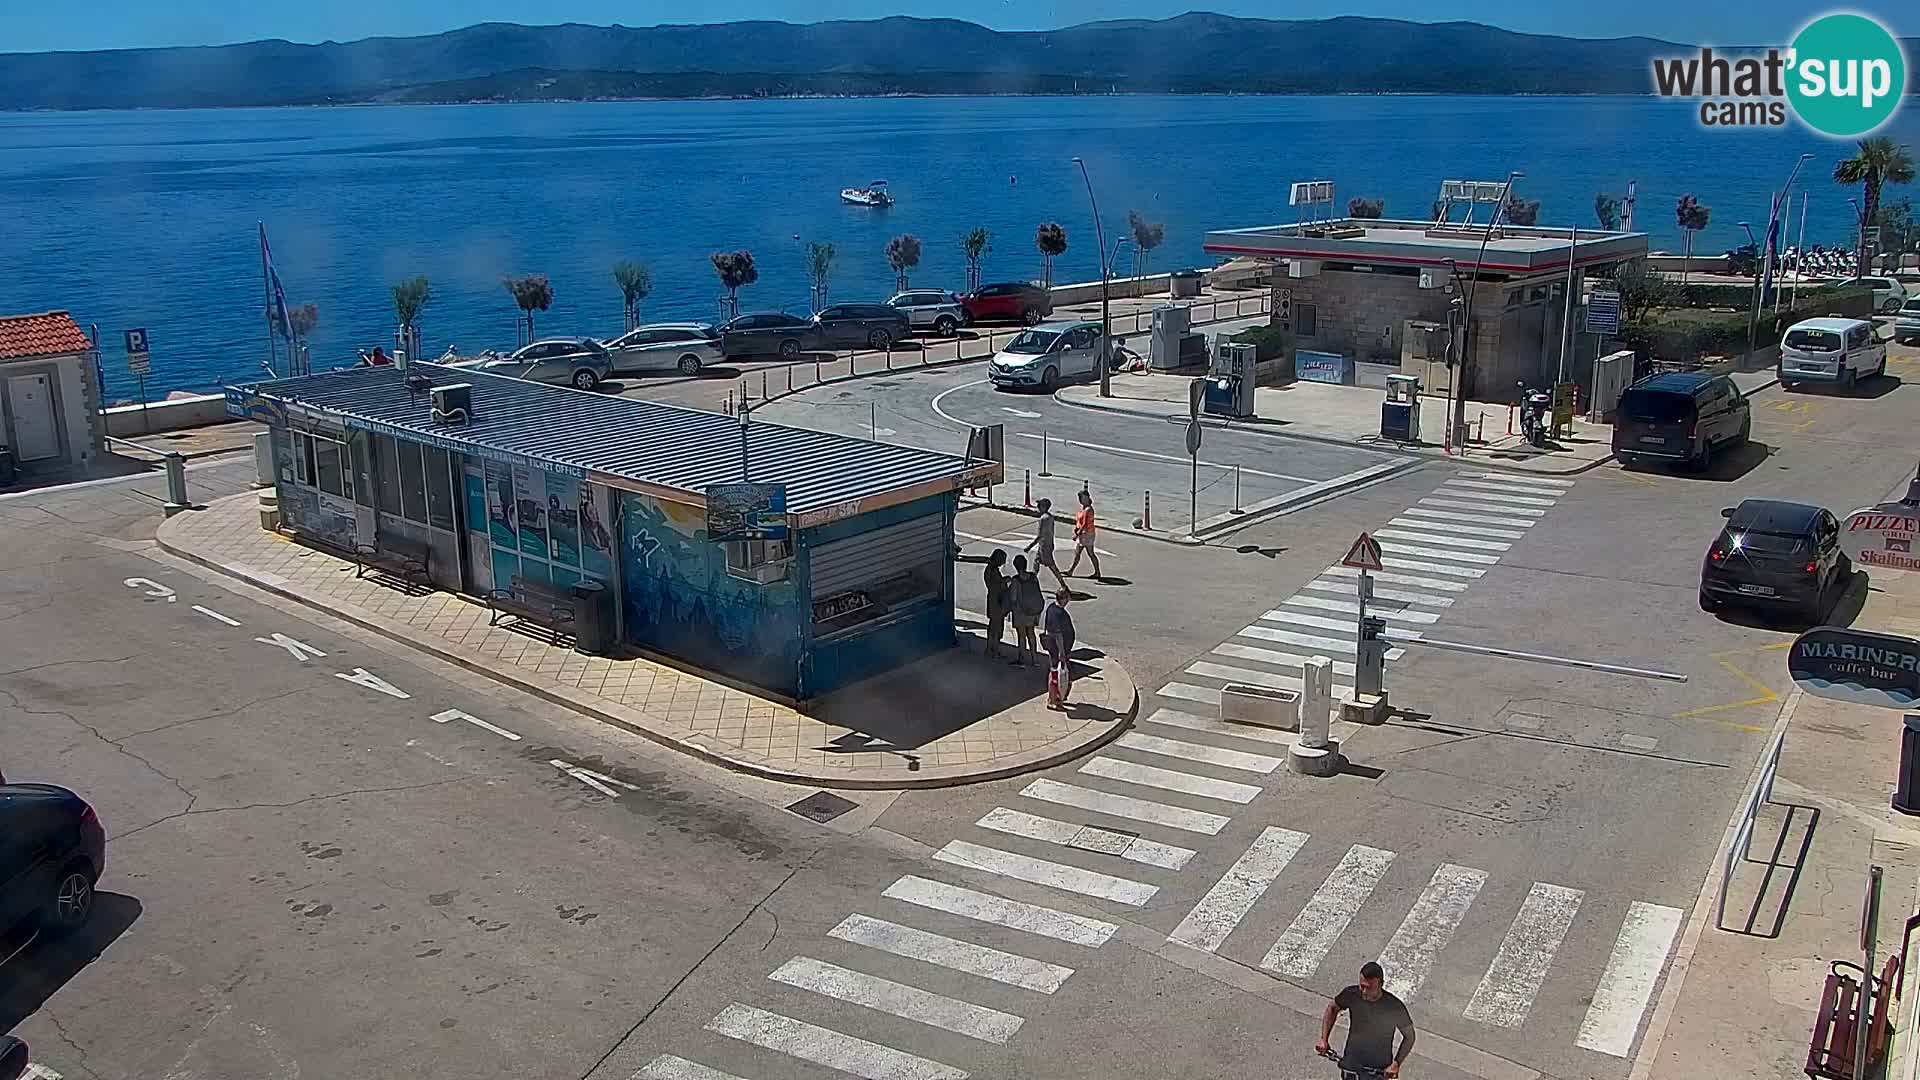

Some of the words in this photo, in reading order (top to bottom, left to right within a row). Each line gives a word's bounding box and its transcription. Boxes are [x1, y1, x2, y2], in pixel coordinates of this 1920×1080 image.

[129, 332, 142, 350] P
[529, 457, 554, 470] TICKET
[555, 462, 583, 477] OFFICE
[1849, 516, 1920, 533] PIZZE
[1801, 643, 1920, 673] MARINER
[1828, 662, 1866, 674] caffe
[1871, 666, 1897, 680] bar
